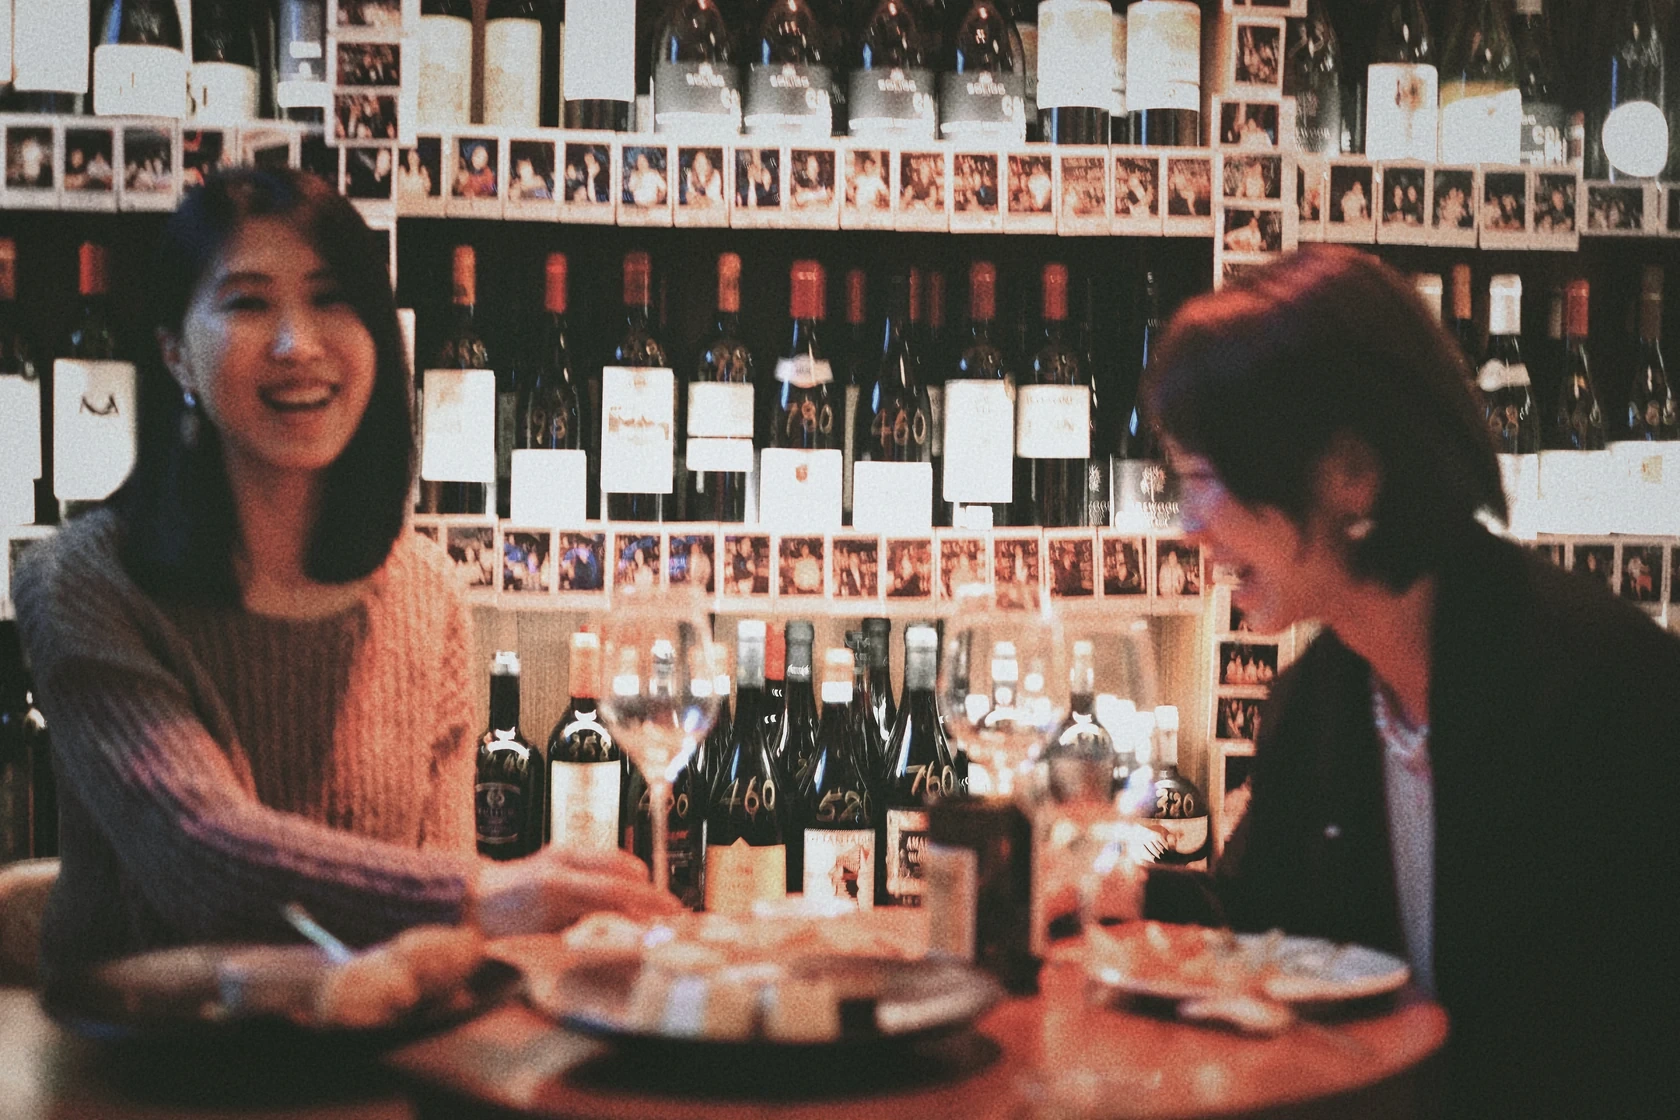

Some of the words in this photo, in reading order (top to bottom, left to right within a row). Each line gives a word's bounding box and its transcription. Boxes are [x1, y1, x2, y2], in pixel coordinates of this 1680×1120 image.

[785, 399, 833, 437] 780
[720, 775, 775, 813] 460
[901, 761, 952, 797] 760
[636, 787, 687, 819] 40
[816, 787, 872, 822] 520
